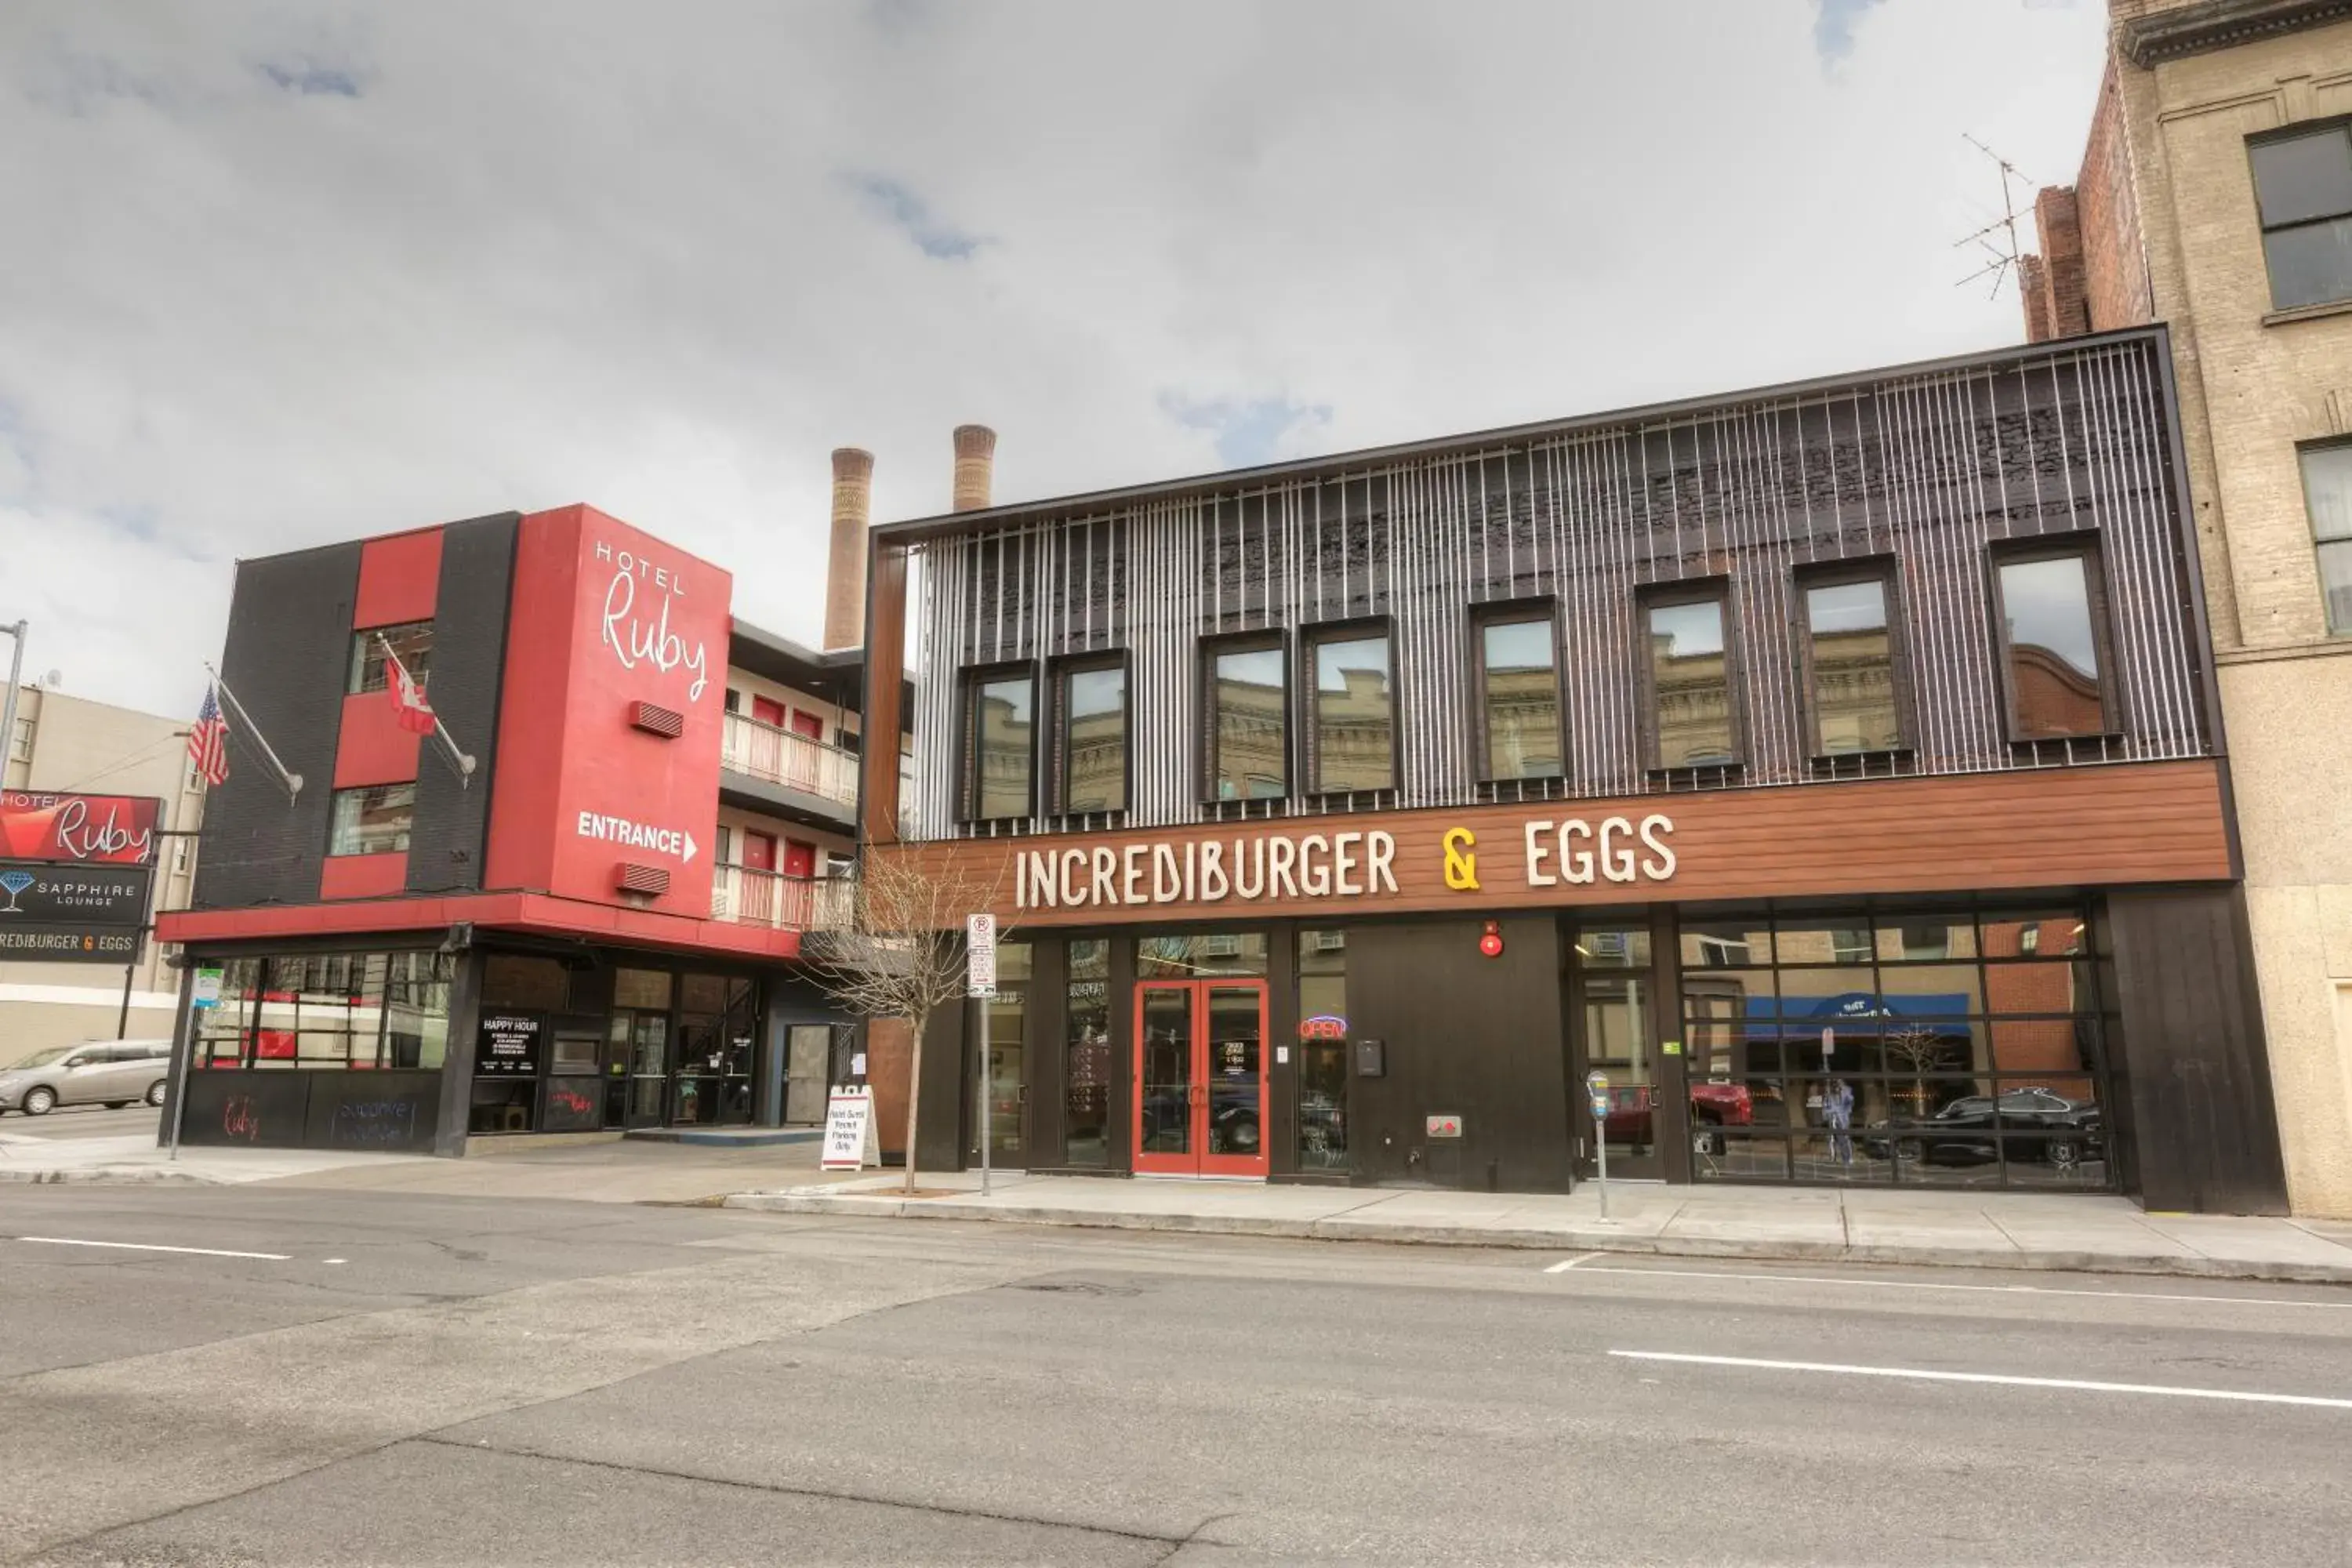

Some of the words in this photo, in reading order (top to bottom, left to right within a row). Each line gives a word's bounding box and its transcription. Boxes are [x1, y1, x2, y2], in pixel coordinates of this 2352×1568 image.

[597, 541, 685, 596] HOTEL
[602, 572, 708, 702] Ruby
[1, 794, 60, 808] HOTEL
[57, 800, 151, 862] Ruby
[579, 811, 682, 855] ENTRANCE
[1016, 830, 1399, 908] INCREDIBURGER
[1443, 827, 1480, 890] &
[1525, 814, 1676, 886] EGGS
[38, 883, 136, 896] SAPPHIRE
[57, 897, 112, 906] LOUNGE
[99, 936, 132, 950] EGGS
[484, 1020, 513, 1030] HAPPY
[514, 1022, 538, 1031] HOUR
[1301, 1021, 1343, 1037] OPEN
